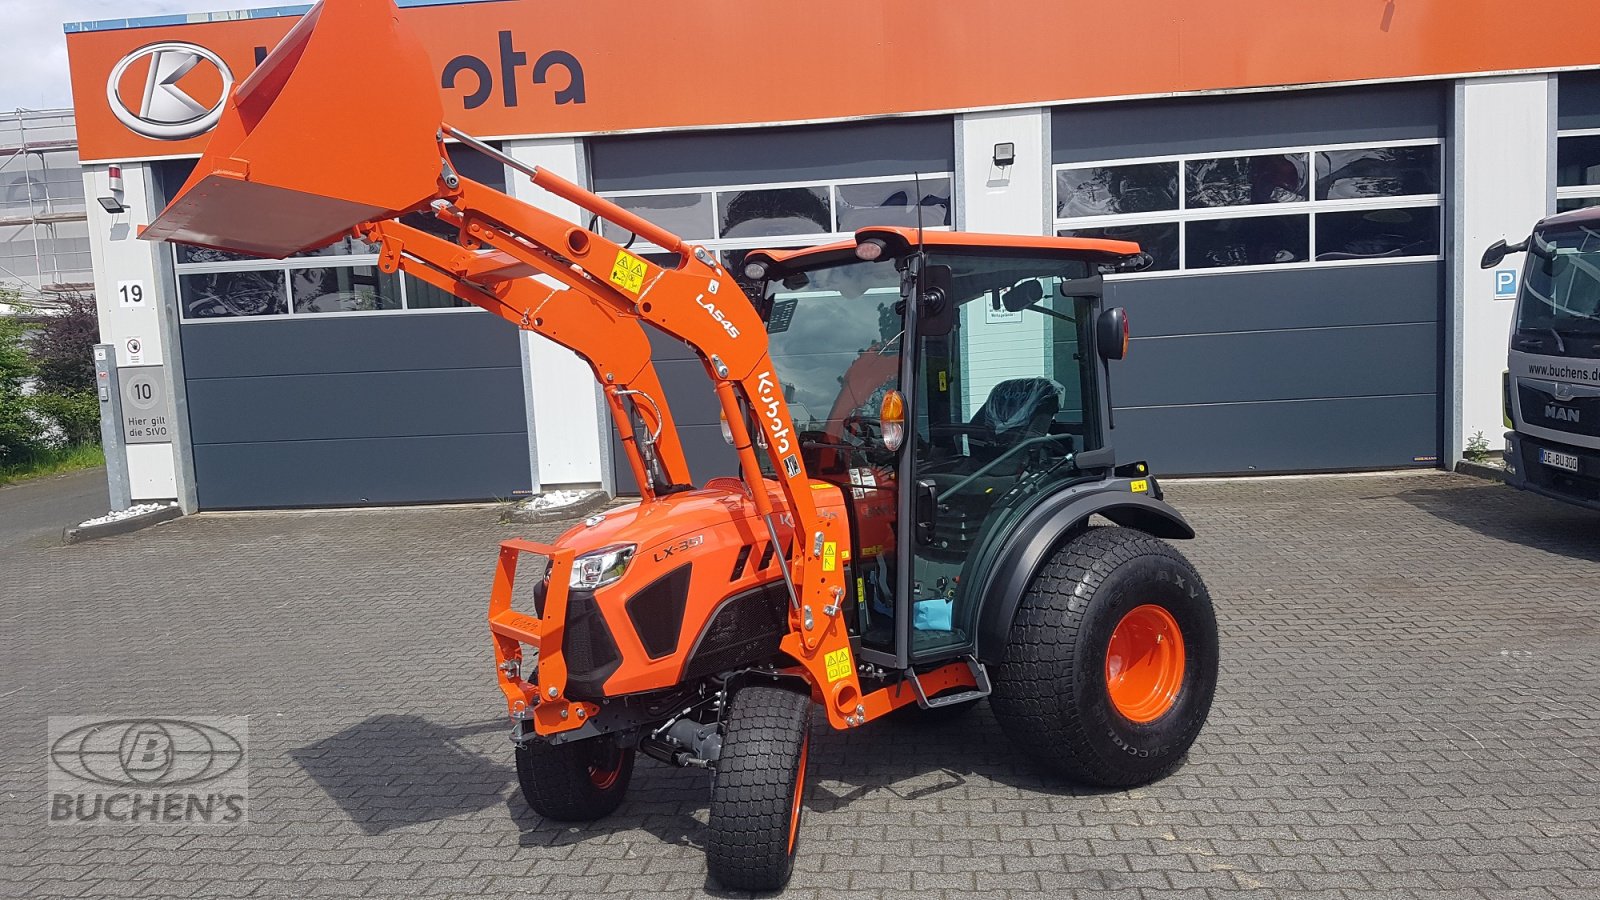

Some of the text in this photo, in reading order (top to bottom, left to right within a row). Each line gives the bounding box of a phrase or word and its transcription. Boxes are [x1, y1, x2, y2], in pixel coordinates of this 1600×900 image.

[1498, 272, 1514, 292] P
[119, 284, 143, 303] 19
[695, 293, 741, 339] LA545
[1528, 364, 1600, 381] www.buchens.d
[134, 383, 152, 400] 10
[128, 415, 166, 427] Hier gilt
[757, 371, 790, 454] Kubota
[1544, 404, 1580, 423] MAN
[129, 426, 167, 437] die StVO
[653, 534, 704, 563] LX-351
